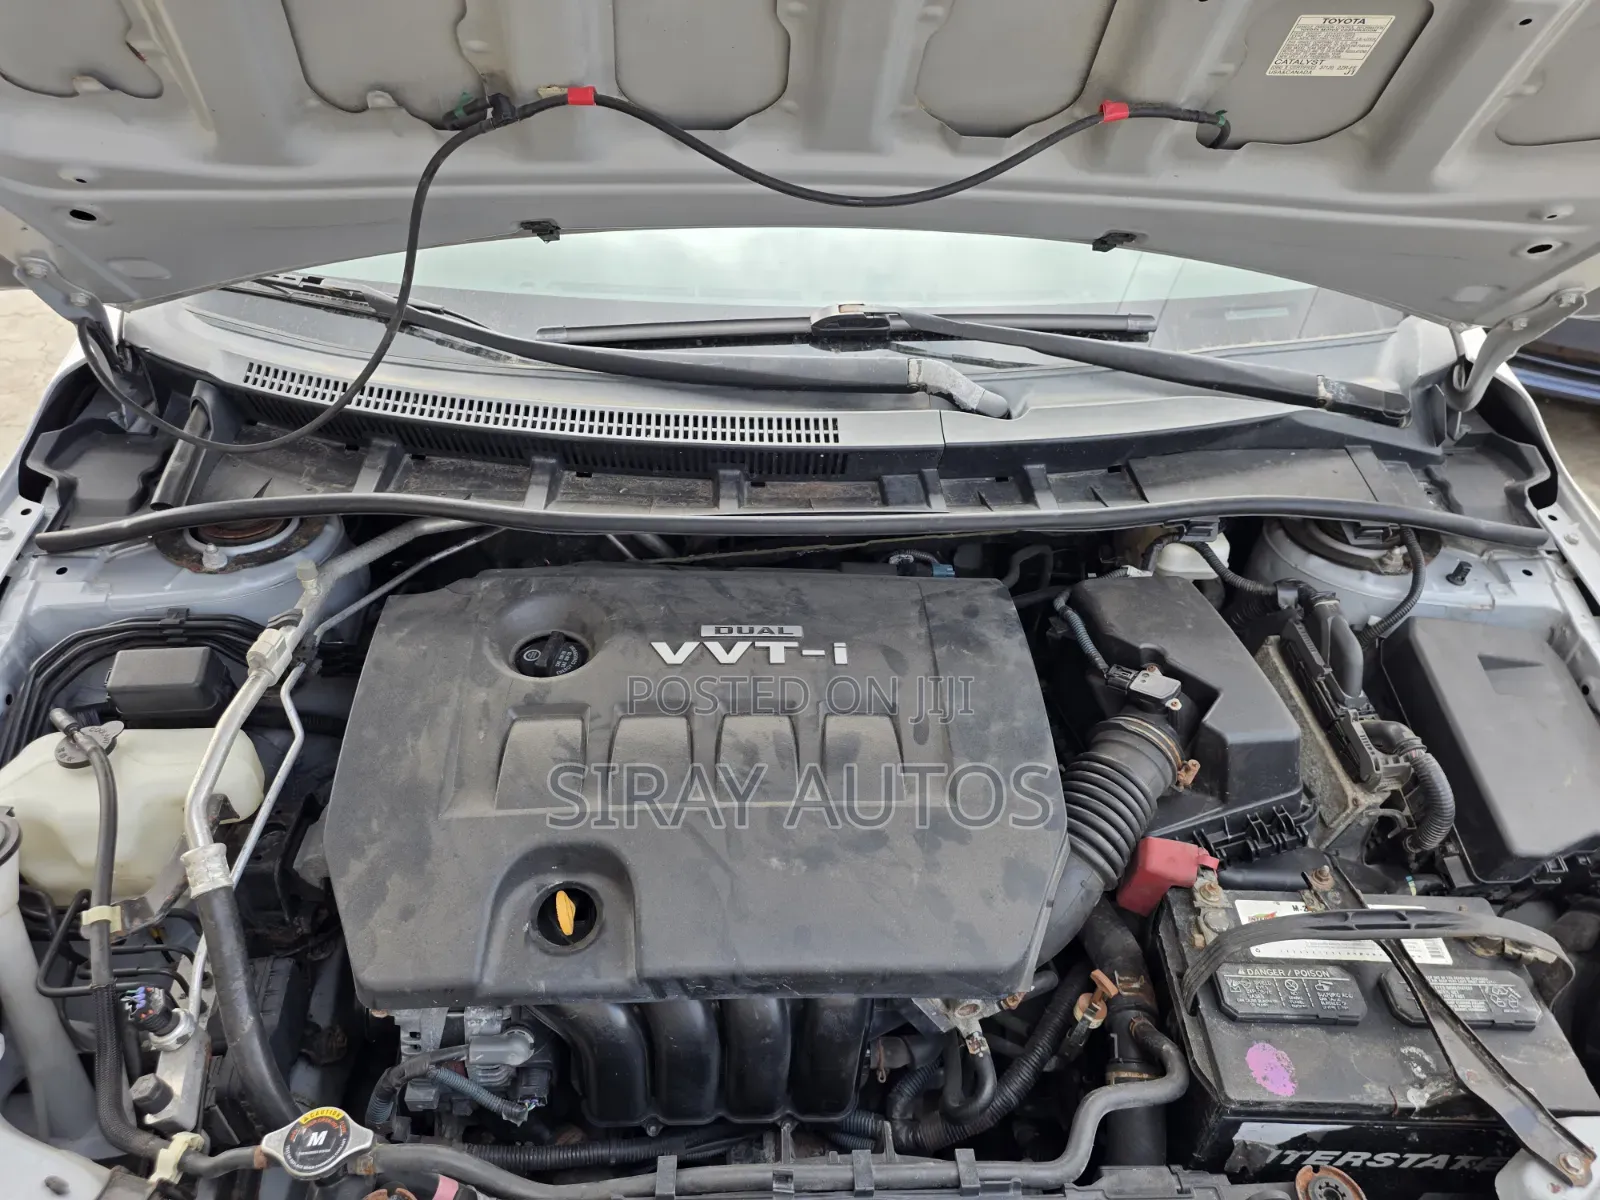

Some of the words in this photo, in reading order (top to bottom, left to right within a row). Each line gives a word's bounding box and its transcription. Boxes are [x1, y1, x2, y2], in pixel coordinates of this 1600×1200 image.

[714, 626, 796, 636] DUAL
[651, 641, 848, 665] VVT-i
[1247, 968, 1285, 977] DANGER
[1294, 969, 1331, 978] POISON
[310, 1109, 342, 1118] CAUTION
[306, 1130, 329, 1147] M
